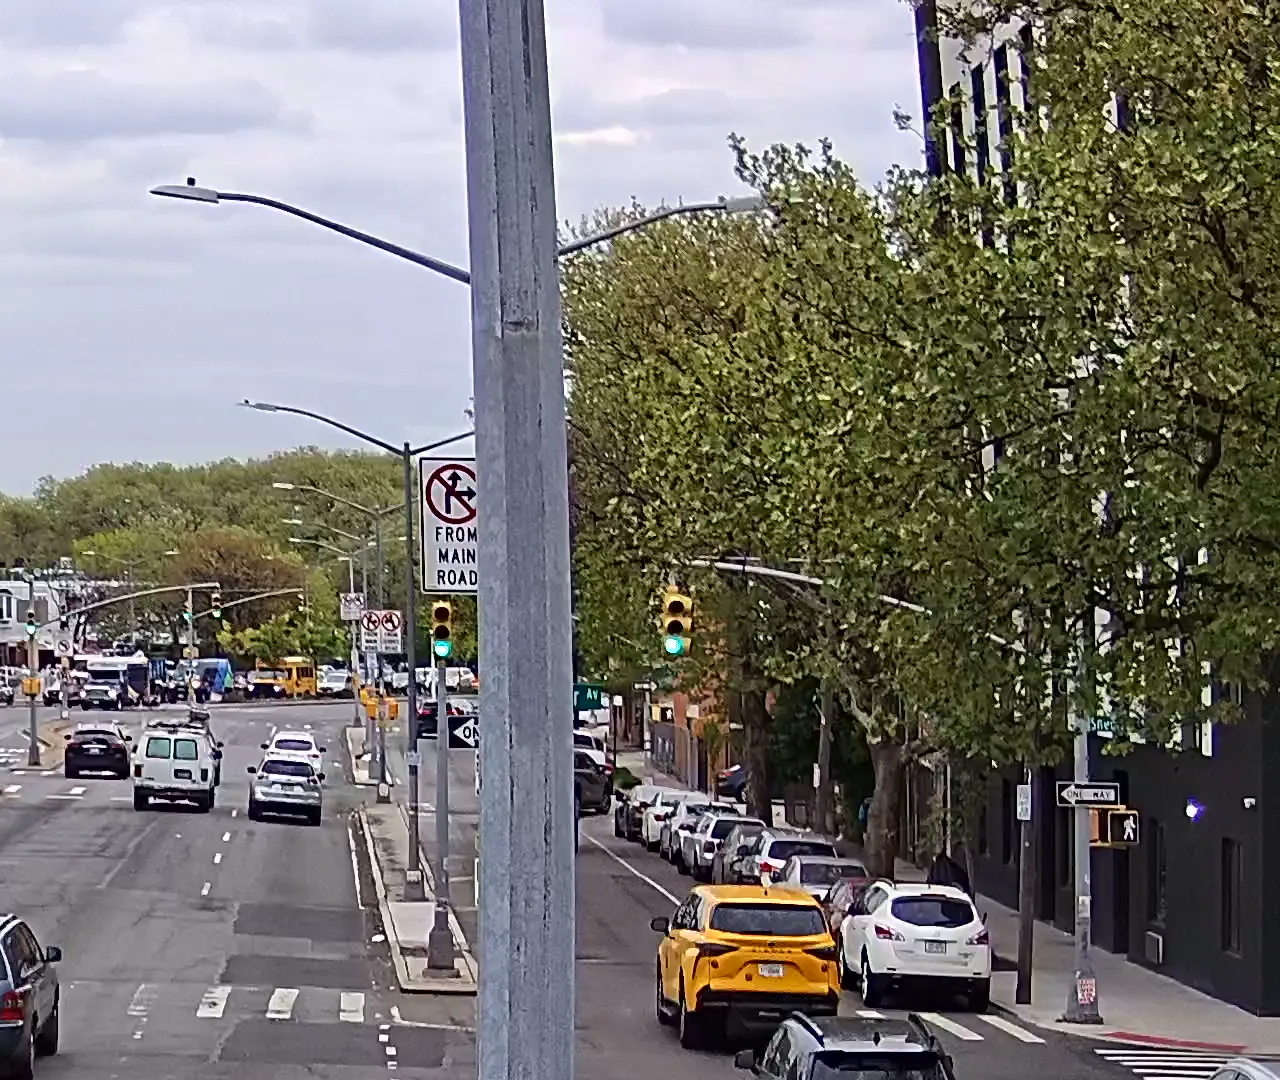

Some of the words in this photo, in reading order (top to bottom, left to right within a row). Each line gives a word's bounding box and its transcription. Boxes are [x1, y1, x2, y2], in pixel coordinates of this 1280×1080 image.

[435, 526, 477, 542] FROM
[438, 548, 476, 564] MAIN
[437, 569, 478, 586] ROAD
[586, 687, 599, 701] Av
[462, 725, 480, 740] ON
